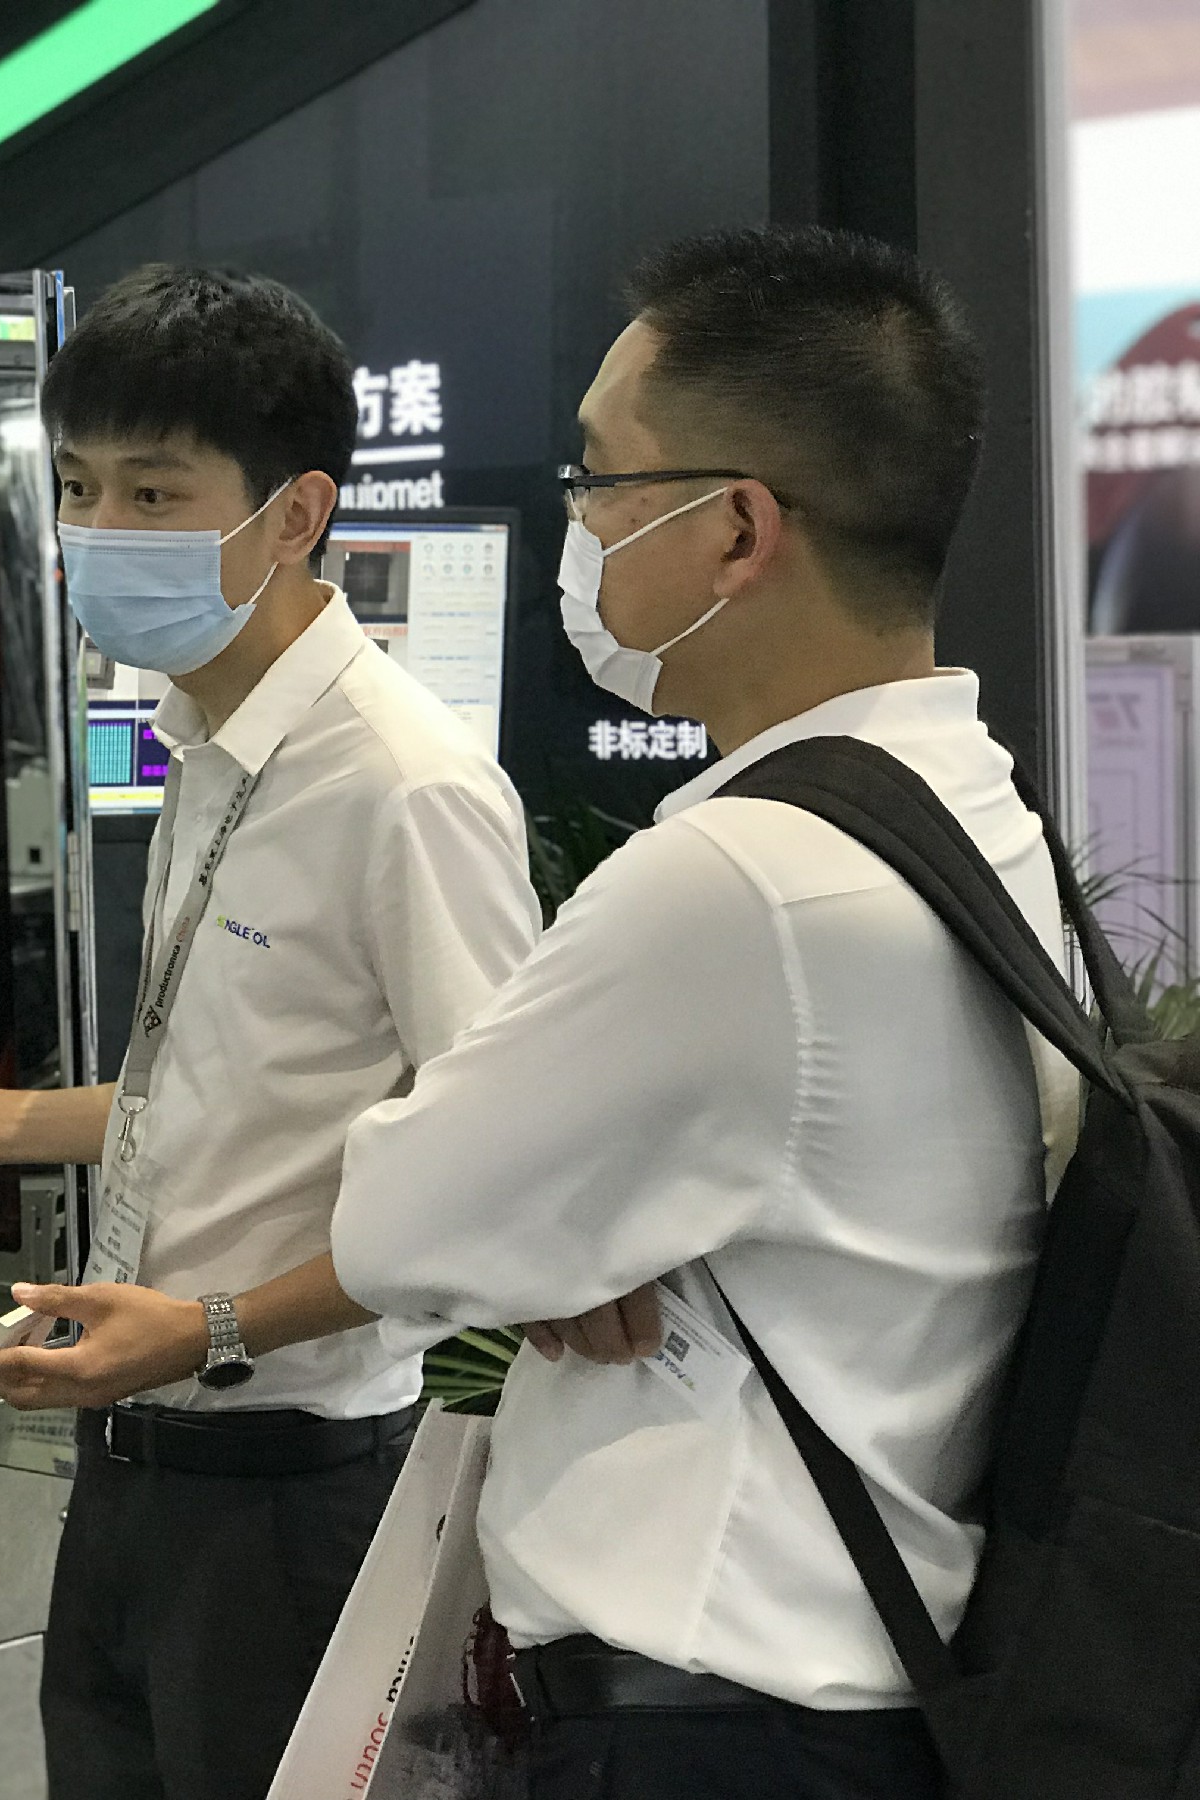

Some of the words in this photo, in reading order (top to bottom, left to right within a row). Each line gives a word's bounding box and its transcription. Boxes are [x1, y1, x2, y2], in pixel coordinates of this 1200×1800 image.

[588, 719, 708, 760] 非标定制
[154, 944, 181, 1008] productronica
